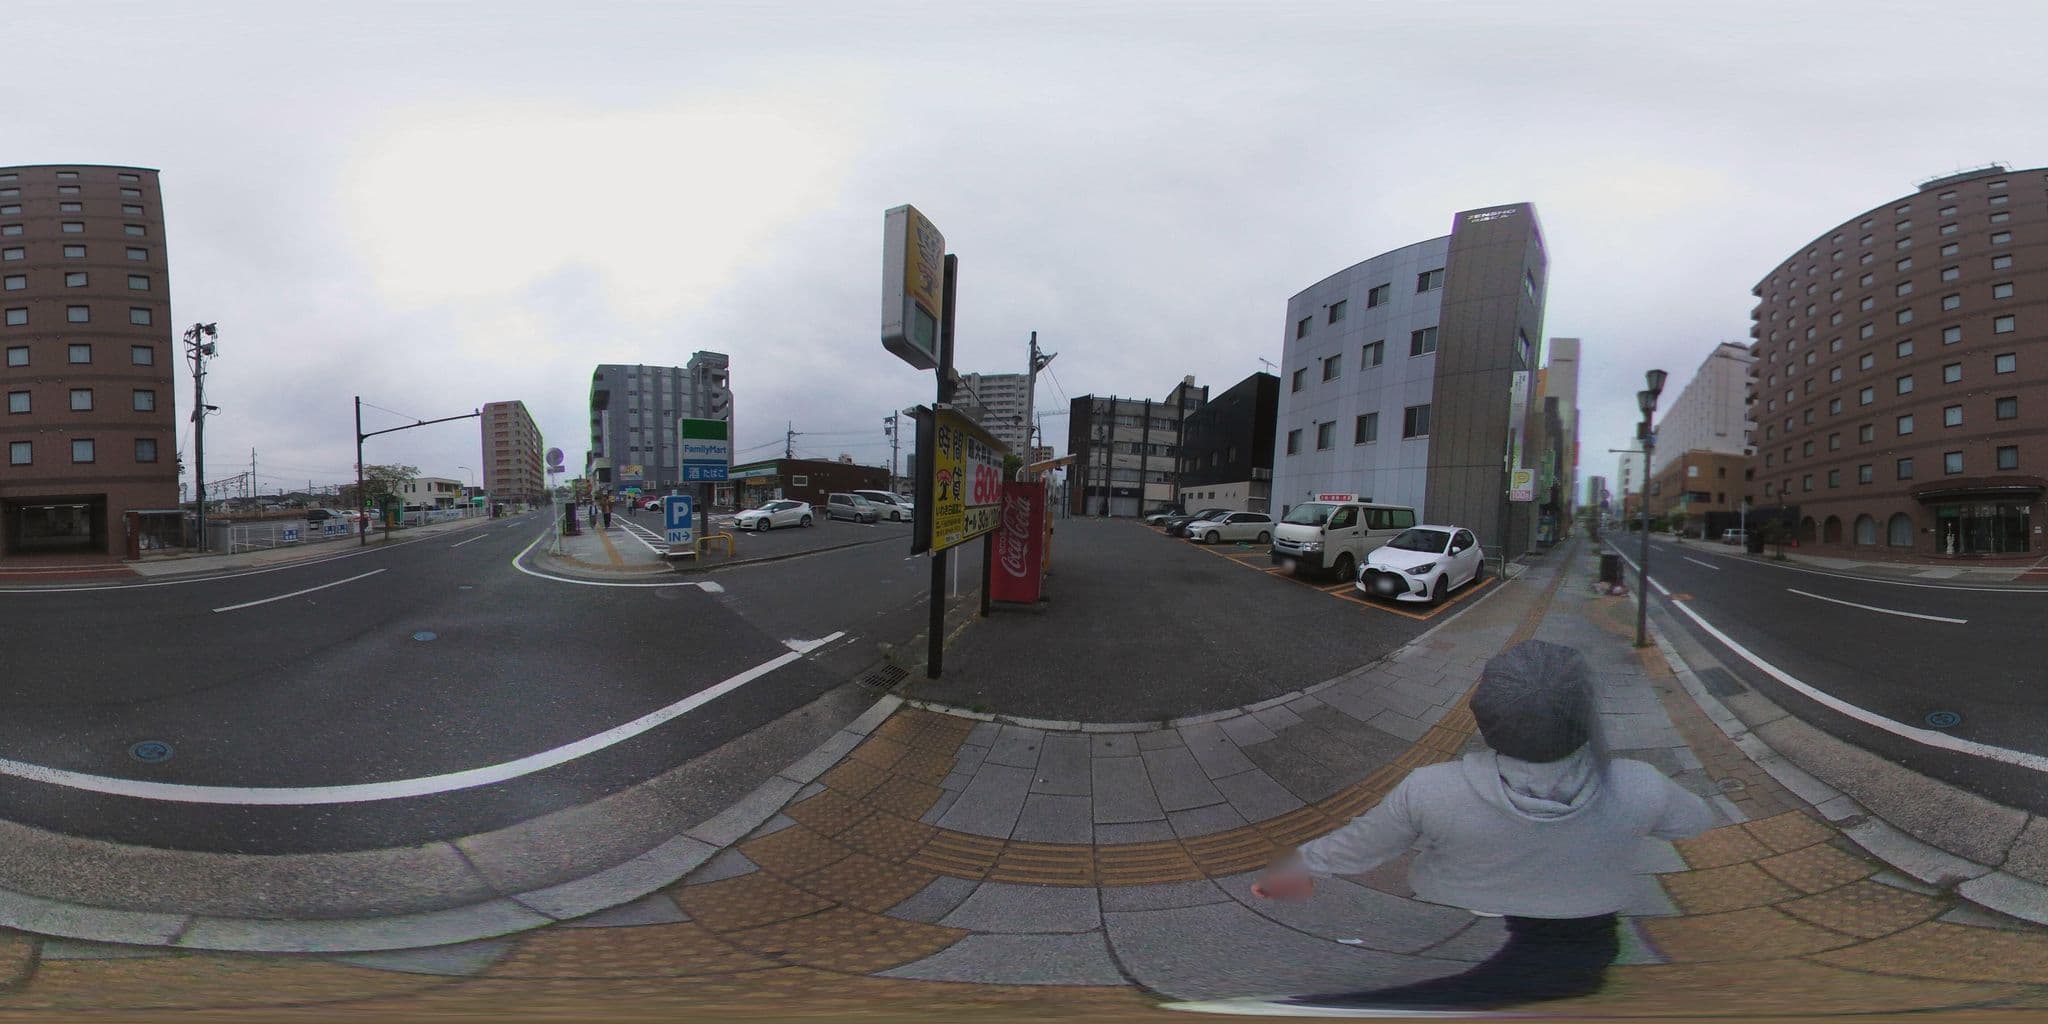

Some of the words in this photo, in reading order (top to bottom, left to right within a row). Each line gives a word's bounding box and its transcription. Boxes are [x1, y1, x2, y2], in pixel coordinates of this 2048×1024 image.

[685, 445, 727, 455] FamilyMart
[673, 502, 688, 524] P
[669, 532, 681, 541] IN
